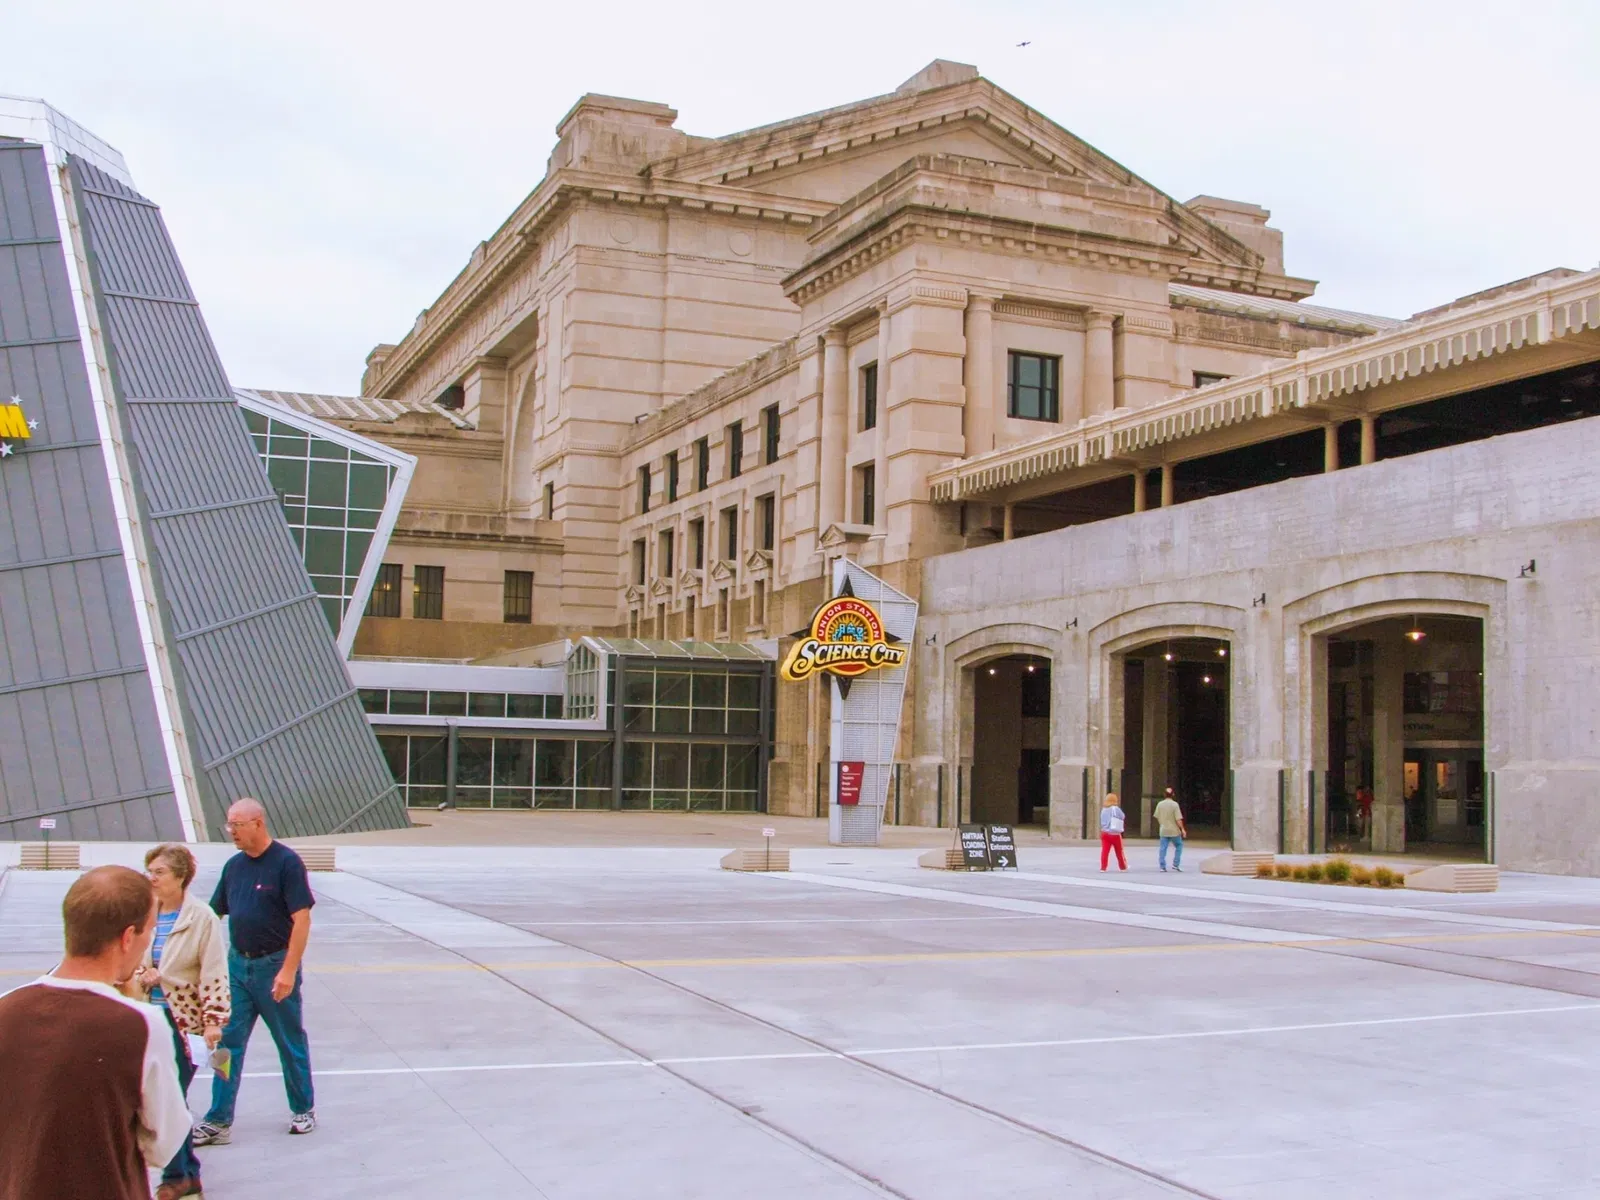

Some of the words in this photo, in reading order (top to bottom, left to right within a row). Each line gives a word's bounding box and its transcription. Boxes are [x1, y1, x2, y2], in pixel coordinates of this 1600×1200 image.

[818, 604, 842, 636] UNION
[846, 602, 880, 638] STATION
[792, 641, 869, 674] SCIENCE
[870, 643, 904, 664] CITY
[992, 826, 1007, 834] Union
[962, 832, 984, 840] AMTRAK
[991, 834, 1011, 842] Station
